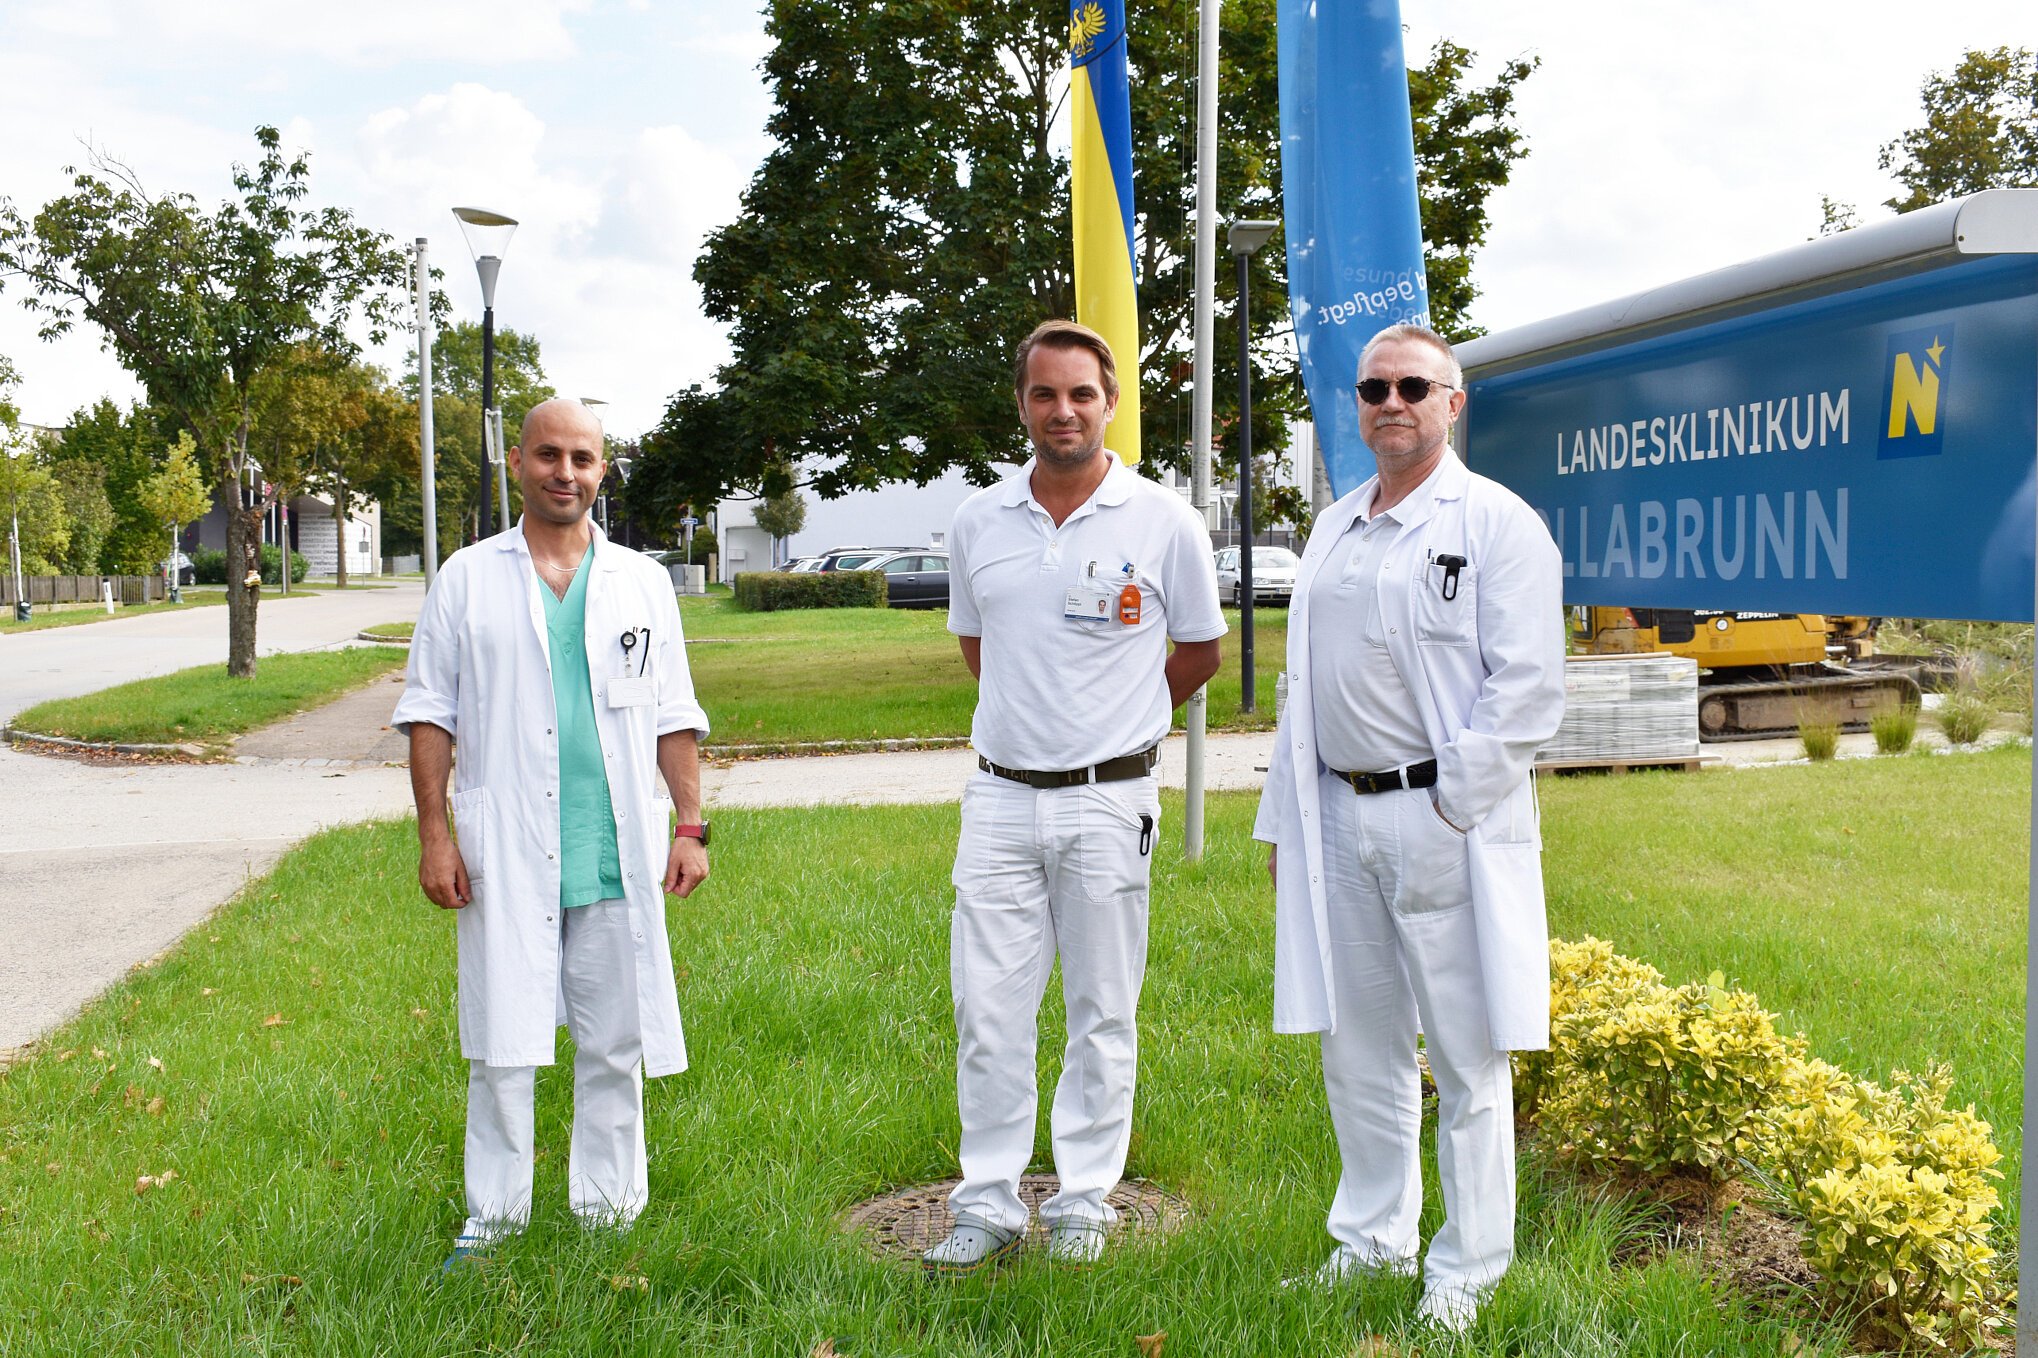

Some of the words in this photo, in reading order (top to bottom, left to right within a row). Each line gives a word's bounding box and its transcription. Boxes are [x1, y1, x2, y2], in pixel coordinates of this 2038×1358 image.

[1341, 265, 1412, 285] esund
[1557, 388, 1850, 475] LANDESKLINIKUM
[1535, 487, 1849, 581] LLABRUNN
